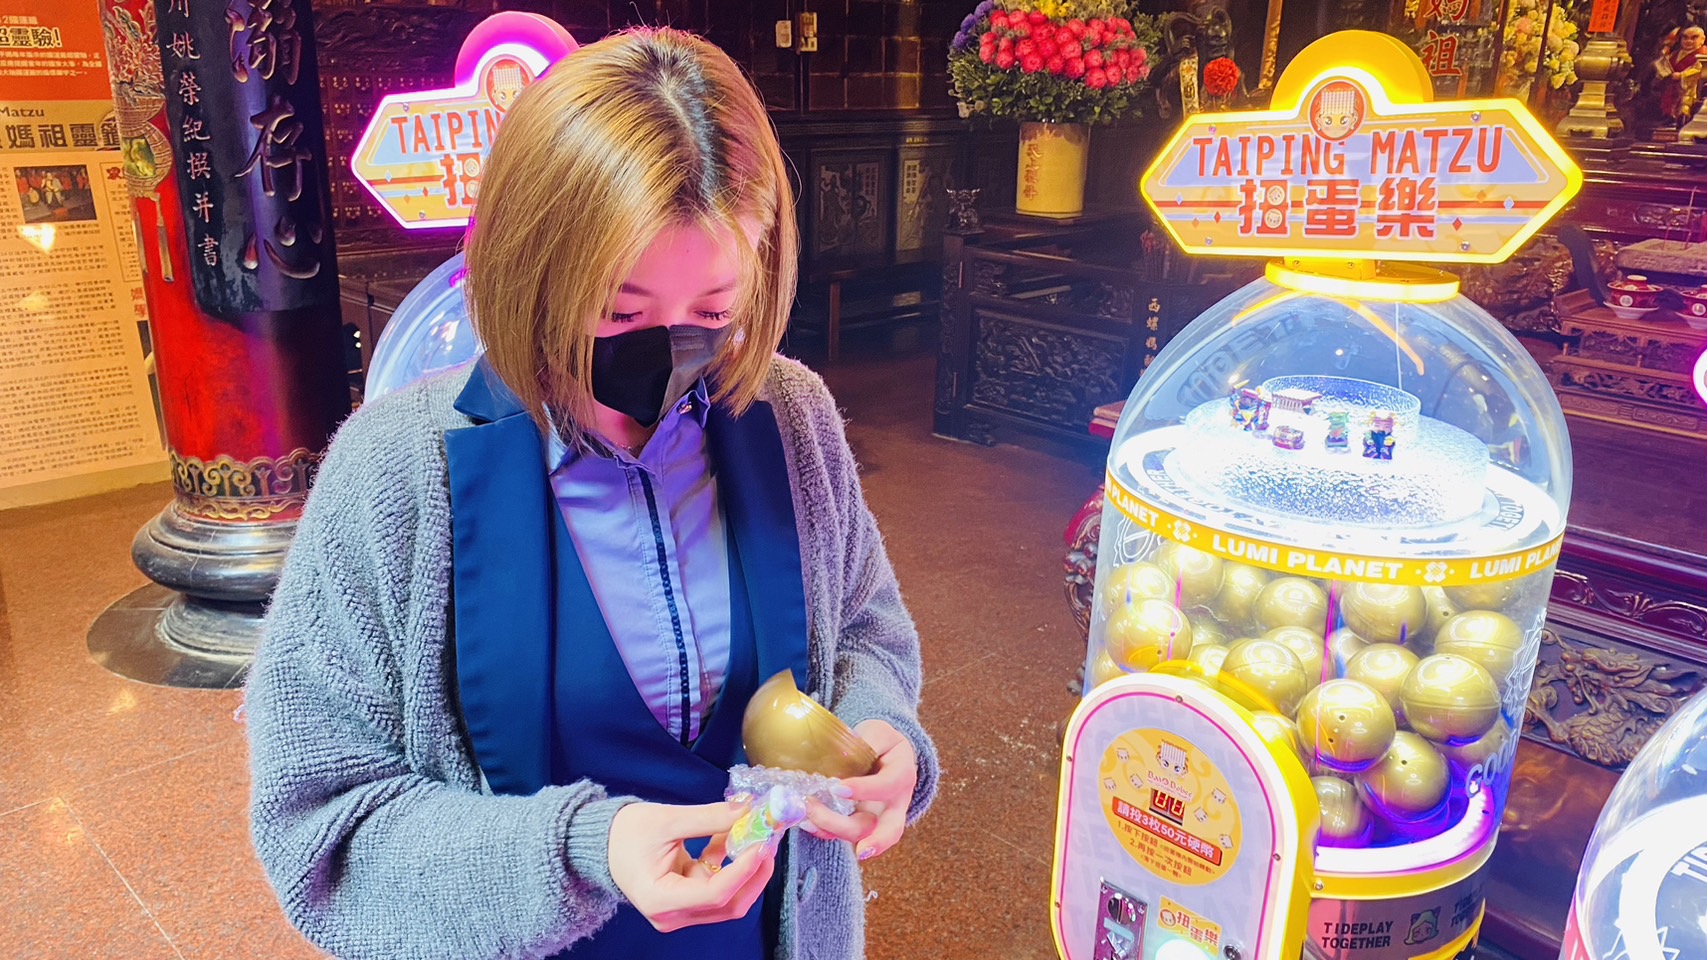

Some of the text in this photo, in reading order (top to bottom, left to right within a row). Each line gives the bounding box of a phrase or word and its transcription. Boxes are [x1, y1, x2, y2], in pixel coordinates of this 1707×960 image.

[0, 106, 45, 118] Matzu
[0, 123, 121, 149] 媽祖靈籤
[1193, 127, 1504, 178] TAIPING MATZU
[1240, 177, 1439, 239] 扭蛋樂
[1111, 485, 1160, 528] PLANET
[1213, 534, 1404, 581] LUMI PLANET
[1470, 556, 1522, 580] LUMI
[1116, 800, 1215, 859] 請投3枚50元硬幣
[1321, 935, 1391, 950] TOGETHER
